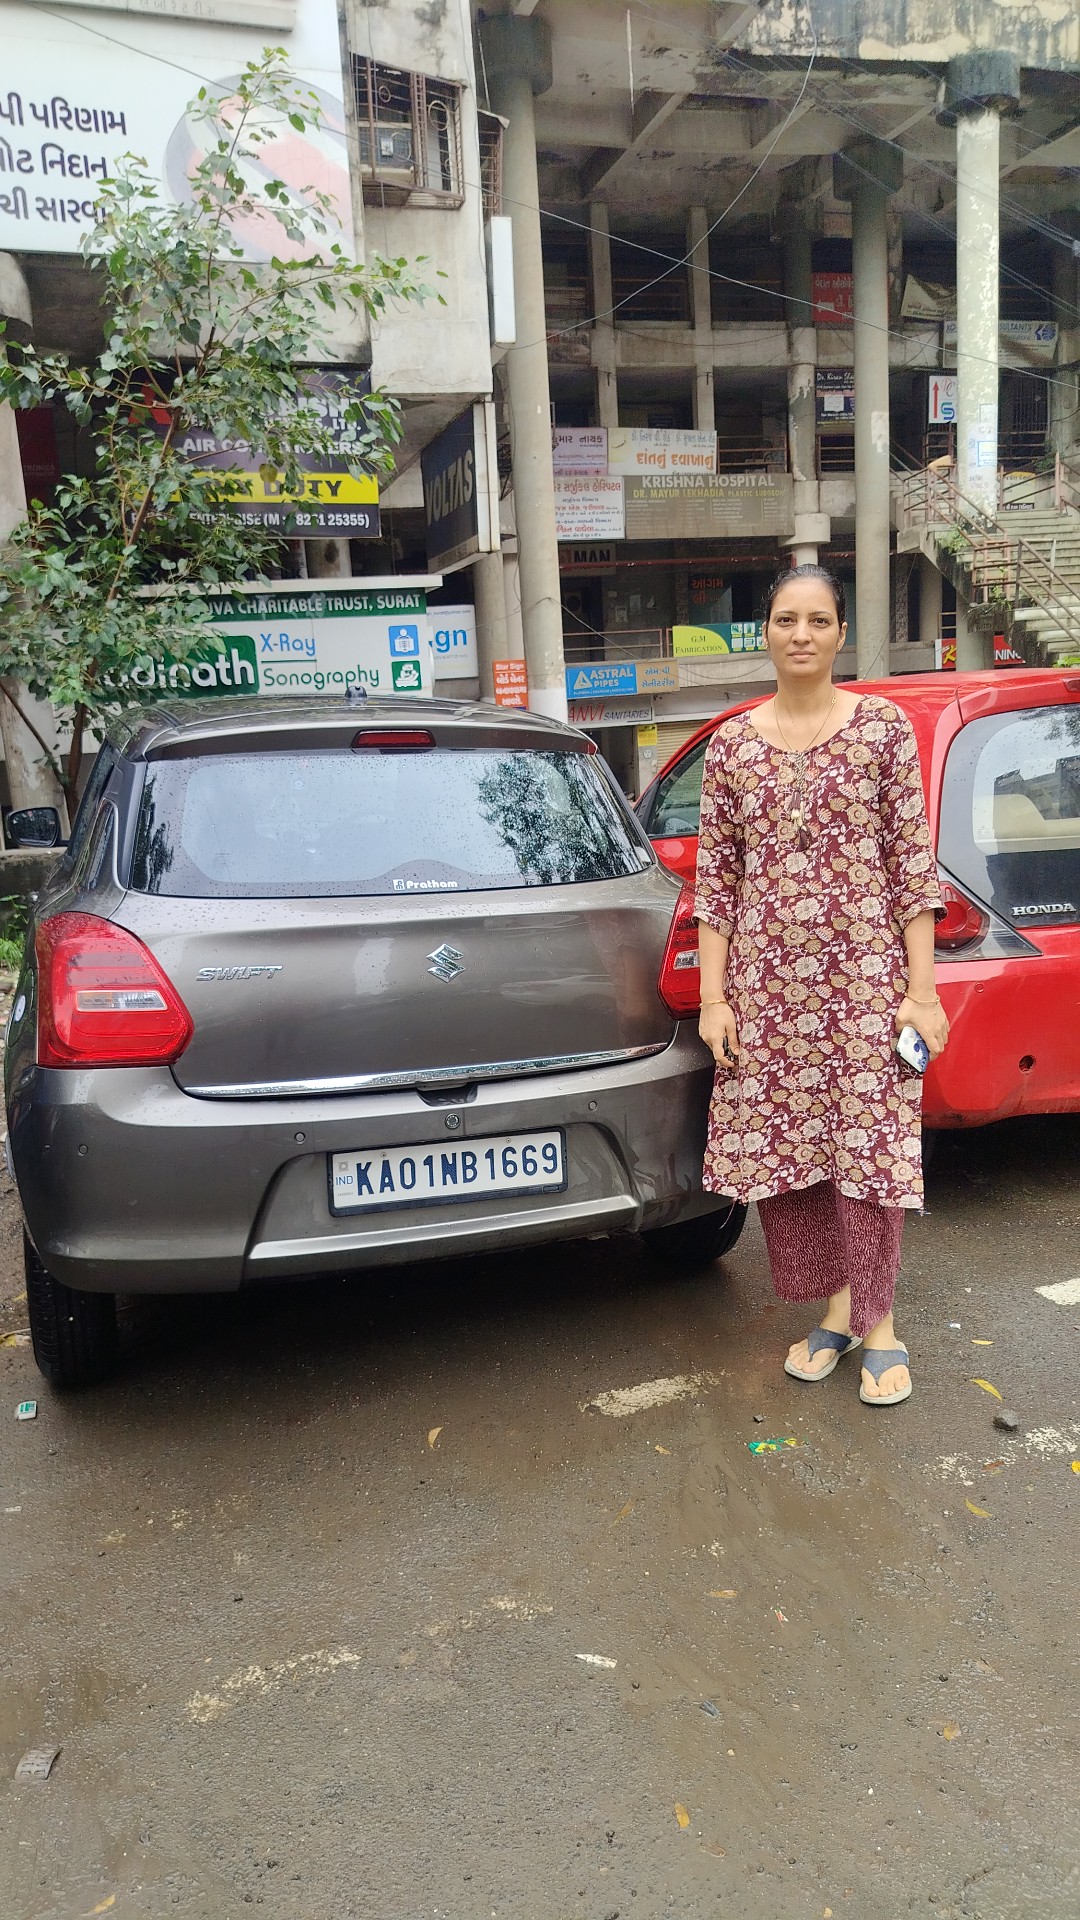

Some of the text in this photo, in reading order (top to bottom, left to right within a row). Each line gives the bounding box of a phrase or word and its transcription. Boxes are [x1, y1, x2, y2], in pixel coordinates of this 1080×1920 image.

[29, 96, 127, 135] પરિણામ
[0, 136, 108, 179] ોટ નિદાન
[183, 438, 216, 453] AIR
[636, 448, 714, 470] દાંતનું દવાખાનું
[264, 480, 342, 497] DUTY
[425, 449, 473, 527] VOLTAS
[642, 475, 775, 488] KRISHNA HOSPITAL
[633, 489, 648, 498] DR.
[650, 489, 680, 498] MAYUR
[682, 489, 725, 498] LEKHADIA
[328, 513, 370, 528] 25355)
[237, 597, 322, 615] CHARITABLE
[326, 597, 373, 612] TRUST,
[377, 594, 421, 610] SURAT
[261, 633, 316, 657] X-Ray
[675, 645, 723, 654] FABRICATION
[264, 664, 379, 690] Sonography
[590, 667, 634, 680] ASTRAL
[593, 679, 620, 688] PIPES
[604, 709, 650, 721] SANITARIES
[406, 879, 458, 889] Pratham
[1011, 903, 1077, 916] HONDA
[196, 965, 283, 981] SWIFT
[335, 1142, 558, 1196] IND KA01NB1669
